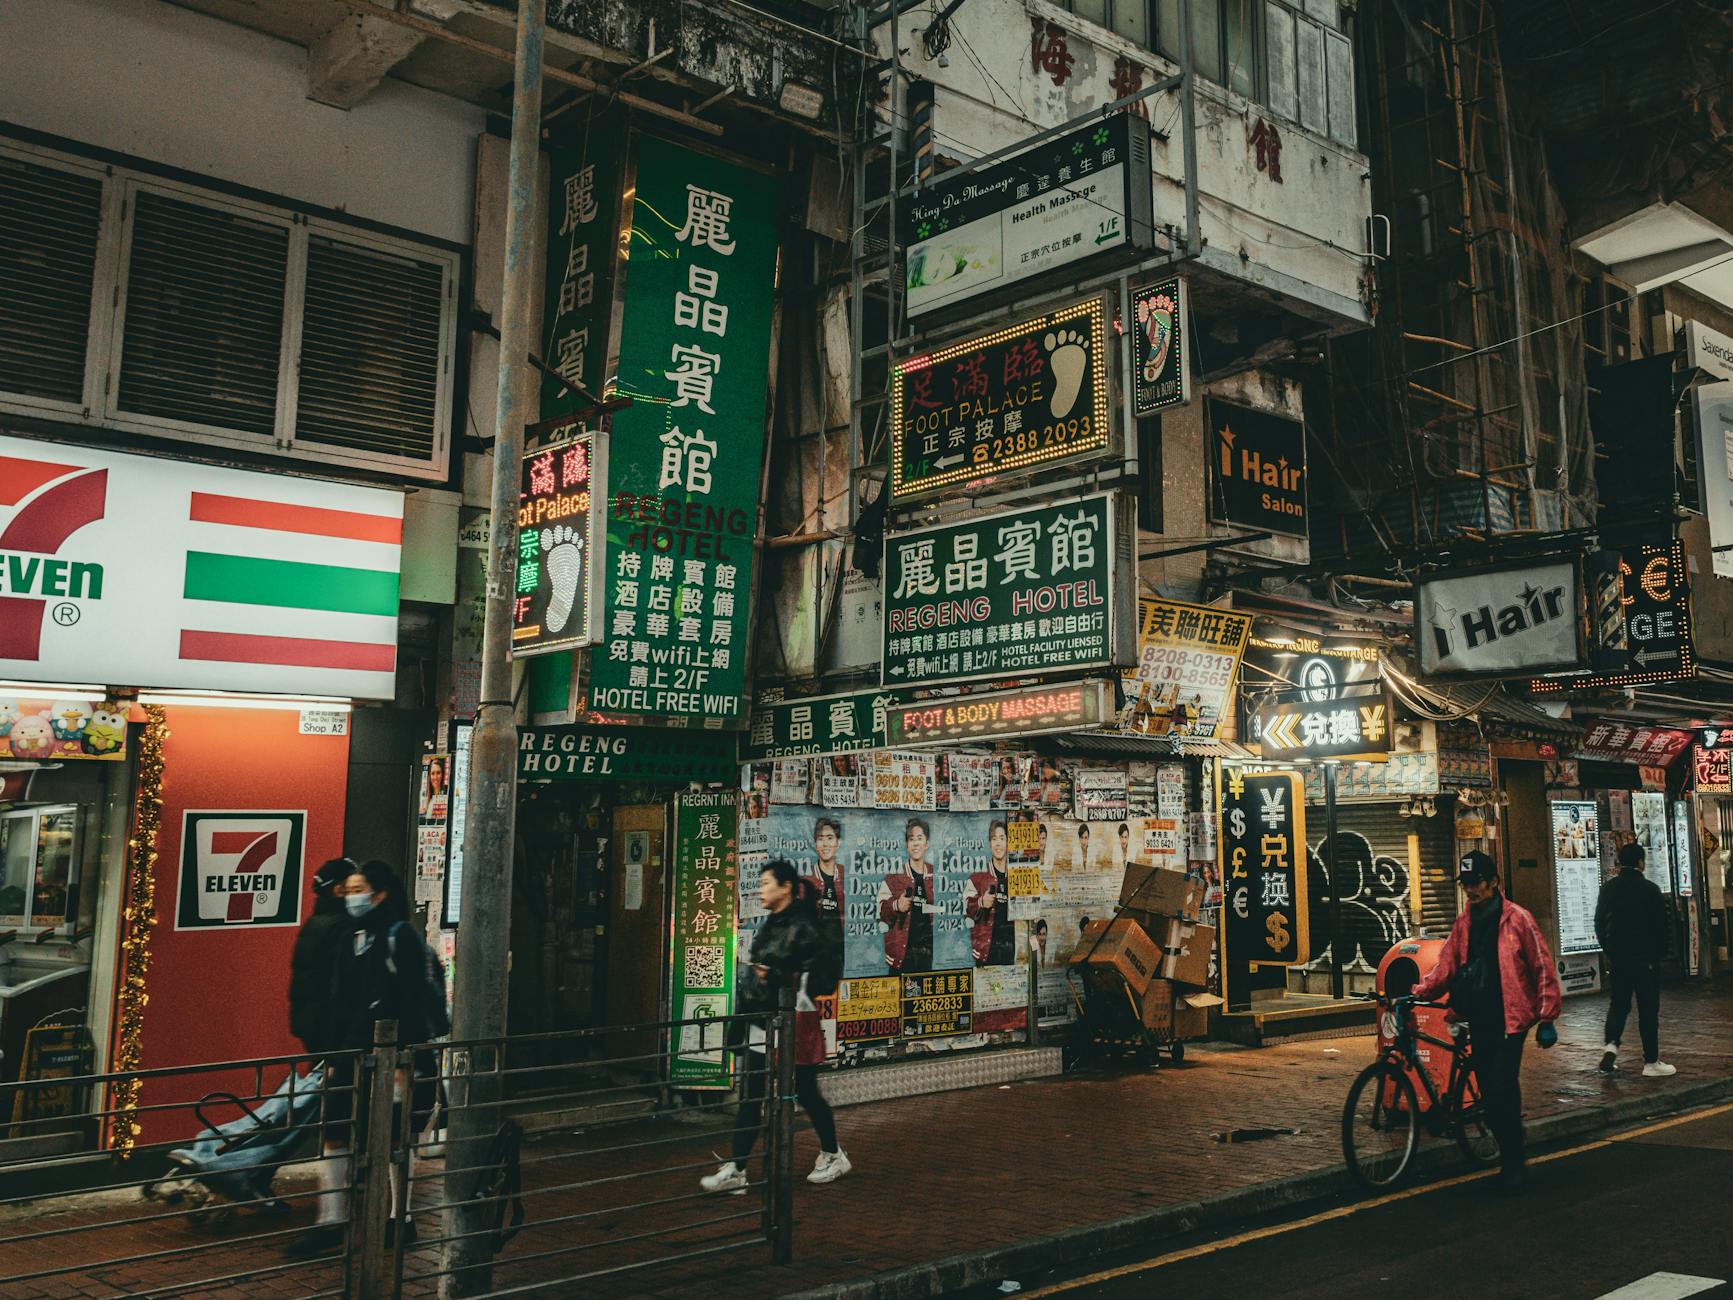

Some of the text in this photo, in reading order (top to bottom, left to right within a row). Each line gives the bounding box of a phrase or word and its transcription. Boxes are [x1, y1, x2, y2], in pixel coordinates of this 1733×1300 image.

[942, 193, 961, 210] Da
[962, 175, 1016, 205] Massage
[1011, 183, 1096, 225] Health Massage
[1098, 217, 1119, 234] 1/F
[1019, 232, 1083, 264] 正宗穴位按摩
[556, 163, 599, 441] 麗晶賓
[659, 183, 738, 494] 麗晶賓館
[904, 380, 1045, 438] FOOT PALACE
[922, 410, 1024, 456] 正宗按摩
[991, 415, 1092, 460] 2388 2093
[904, 458, 930, 481] 2/F
[1241, 448, 1302, 492] Hair
[614, 490, 748, 535] REGENG
[1261, 492, 1304, 518] Salon
[626, 524, 731, 561] HOTEL
[892, 509, 1100, 600] 麗晶賓館
[617, 550, 737, 590] 持牌賓館
[614, 579, 735, 618] 酒店設備
[888, 579, 1104, 633] REGENG HOTEL
[611, 608, 733, 646] 豪華套房
[1460, 580, 1567, 650] Hair
[1622, 610, 1676, 642] GE
[888, 611, 1105, 656] 持牌賓館 酒店設備 豪華套房 歡迎自由行
[1001, 635, 1103, 659] HOTEL FACILITY LIENSED
[1001, 647, 1104, 669] HOTEL FREE WIFI
[1142, 646, 1234, 672] 8208-0313
[1138, 662, 1230, 688] 8100-8565
[593, 686, 652, 712] HOTEL
[655, 690, 700, 714] FREE
[703, 693, 738, 715] WIFI
[901, 691, 1083, 732] FOOT & BODY MASSAGE
[303, 723, 343, 734] Shop A2
[519, 732, 628, 756] REGENG
[522, 753, 614, 775] HOTEL
[1709, 763, 1728, 774] 2/F
[681, 793, 719, 807] REGRNT
[690, 813, 723, 935] 麗晶賓館
[848, 850, 905, 876] Edan
[937, 848, 988, 874] Edan
[847, 922, 879, 937] 2024
[937, 918, 966, 933] 2024
[922, 975, 970, 996] 旺舖專家
[912, 997, 963, 1014] 23662833
[837, 1017, 899, 1039] 2692 0088
